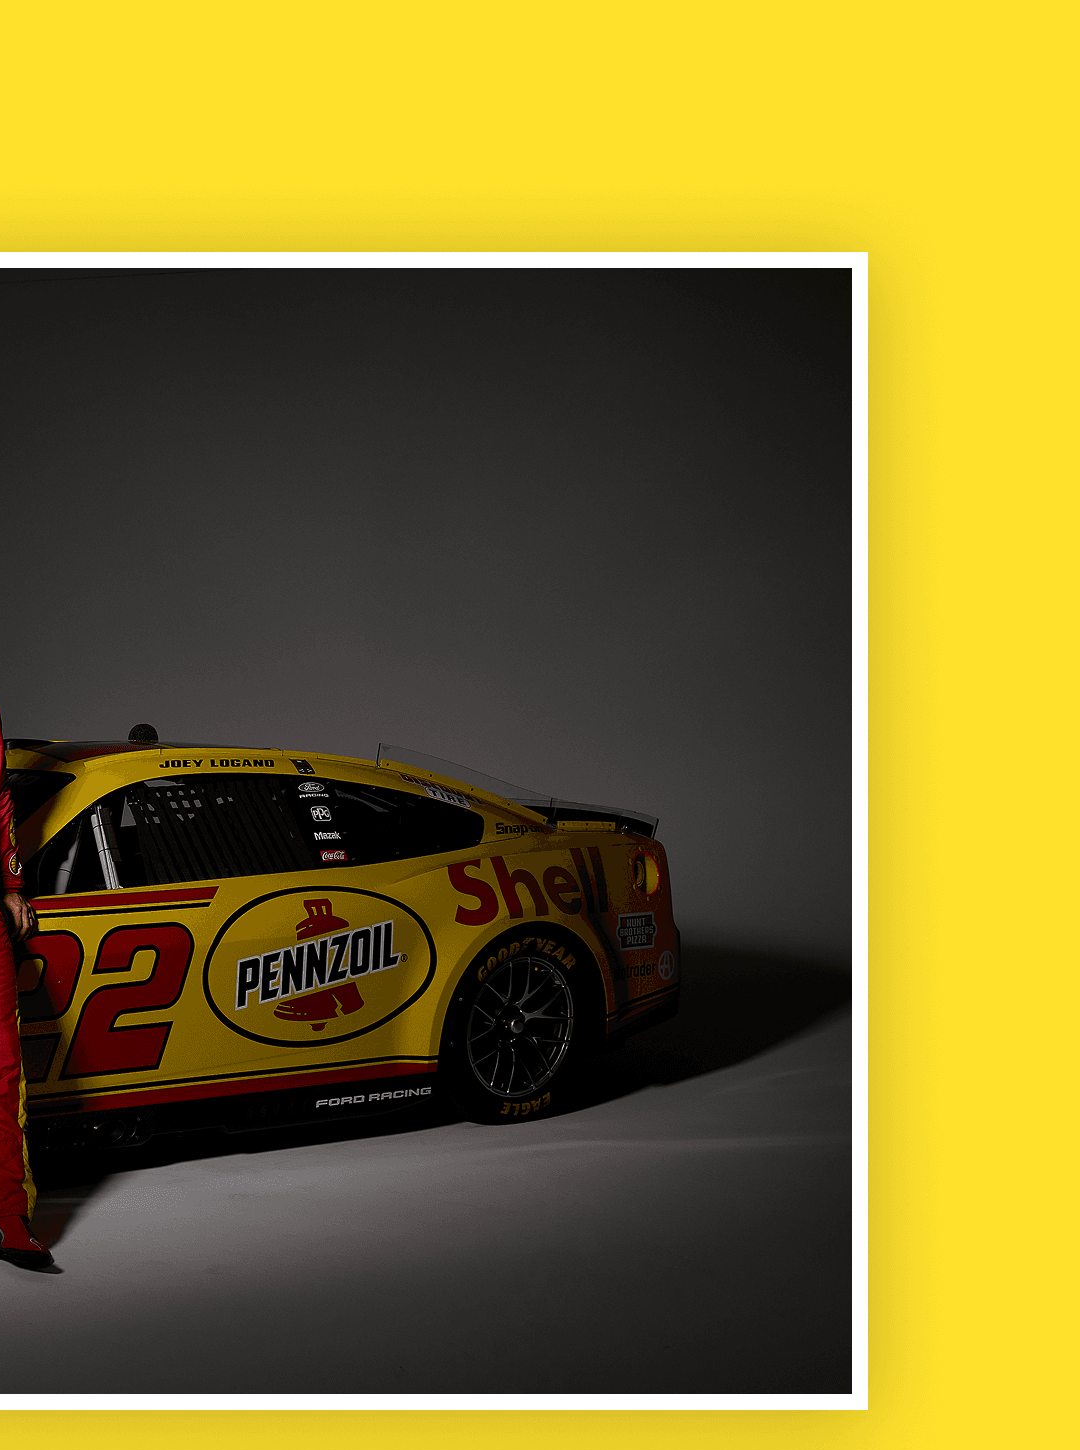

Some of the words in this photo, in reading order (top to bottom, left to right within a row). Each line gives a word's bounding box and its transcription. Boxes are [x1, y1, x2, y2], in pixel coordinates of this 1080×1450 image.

[159, 759, 203, 769] JOEY
[209, 758, 275, 768] LOGANO
[427, 788, 470, 807] TIRE
[311, 806, 331, 820] PPG
[313, 831, 342, 841] Mazak
[447, 846, 609, 927] Shell
[626, 917, 646, 928] HUNT
[619, 926, 654, 937] BROTHERS
[626, 935, 647, 945] PIZZA
[234, 919, 400, 1011] PENNZOIL
[477, 936, 577, 983] GOODYEAR
[315, 1094, 366, 1109] FORD
[367, 1086, 432, 1104] RACING
[500, 1092, 552, 1116] EAGLE
